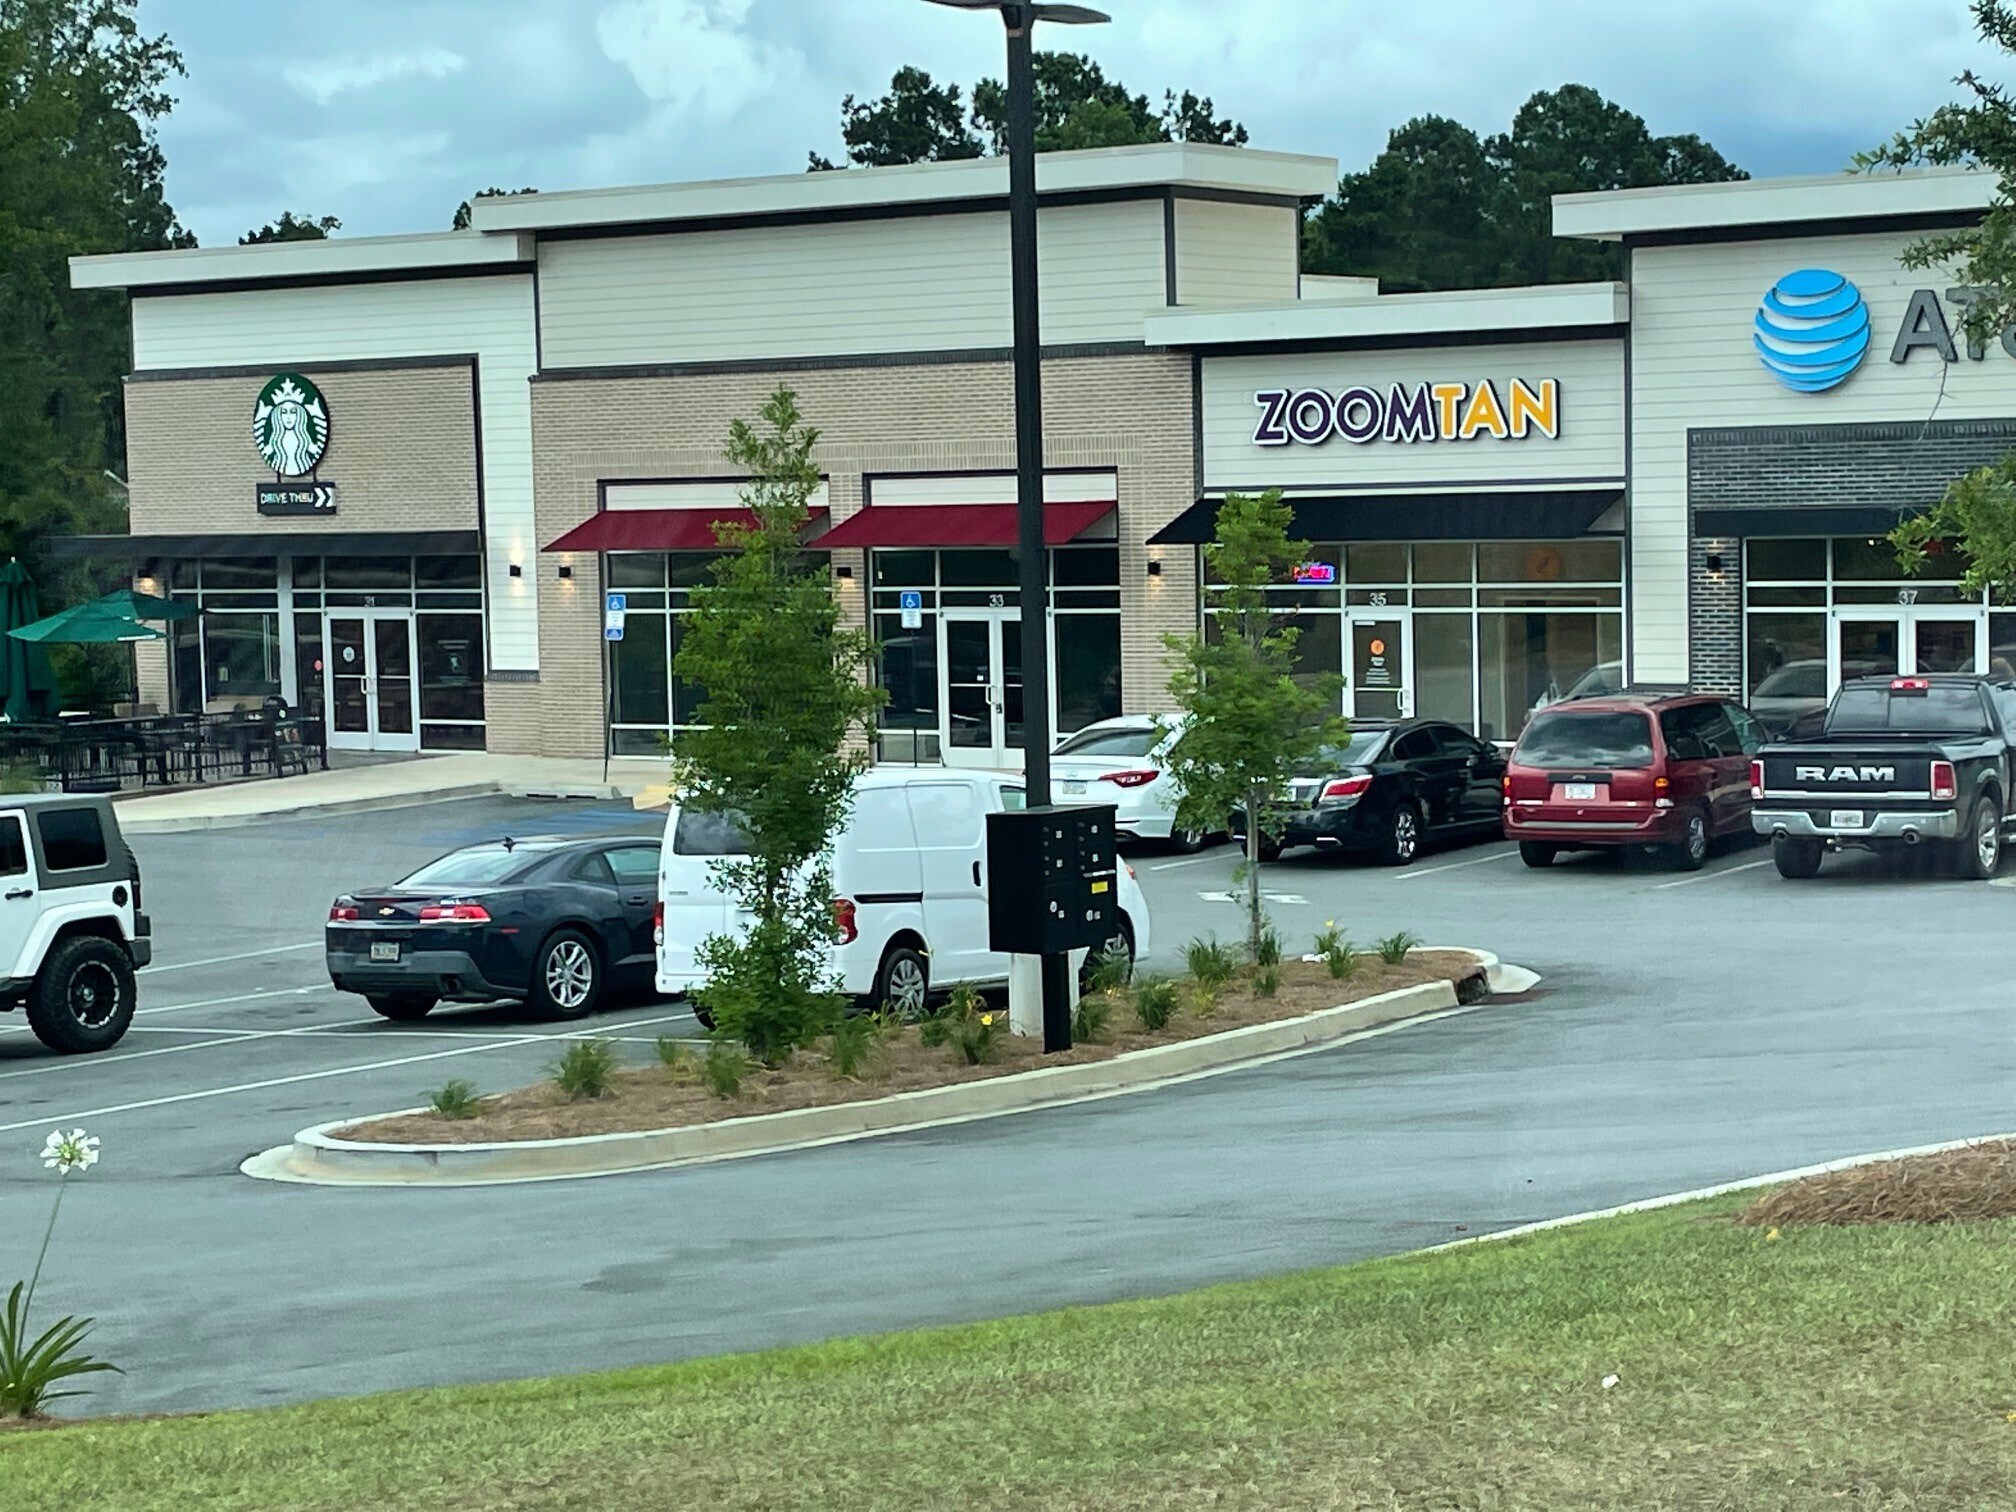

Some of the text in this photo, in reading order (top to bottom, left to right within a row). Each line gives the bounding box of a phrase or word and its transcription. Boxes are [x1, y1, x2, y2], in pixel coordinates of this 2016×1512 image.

[1252, 377, 1563, 447] ZOOMTAN
[989, 593, 1005, 608] 33
[1369, 592, 1387, 607] 35
[1898, 589, 1918, 606] 37
[1795, 766, 1896, 782] RAM
